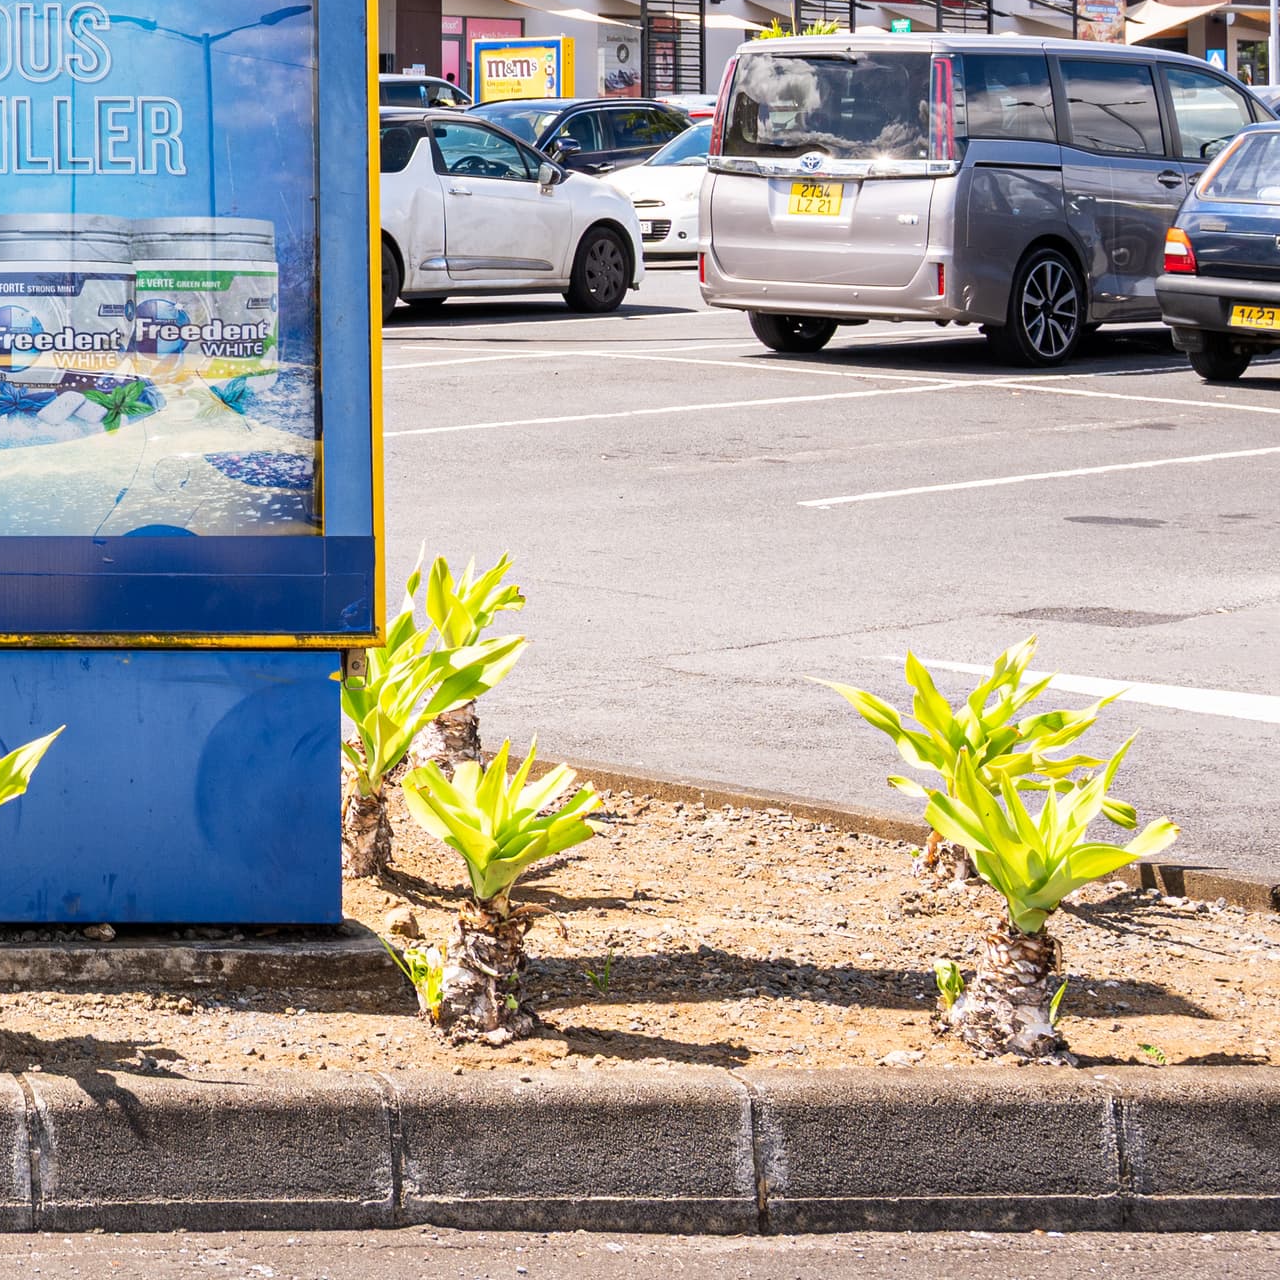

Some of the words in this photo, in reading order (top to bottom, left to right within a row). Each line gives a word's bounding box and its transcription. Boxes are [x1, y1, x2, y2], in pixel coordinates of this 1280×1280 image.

[800, 183, 831, 198] 2734
[796, 199, 813, 213] LZ
[817, 199, 832, 213] 21
[26, 285, 56, 293] STRONG
[57, 285, 76, 293] MINT
[146, 278, 175, 288] VERTE
[176, 280, 200, 288] GREEN
[201, 280, 221, 288] MINT
[1239, 308, 1276, 327] 1423
[136, 317, 268, 342] Freedent
[202, 341, 264, 357] WHITE
[53, 352, 117, 369] WHITE
